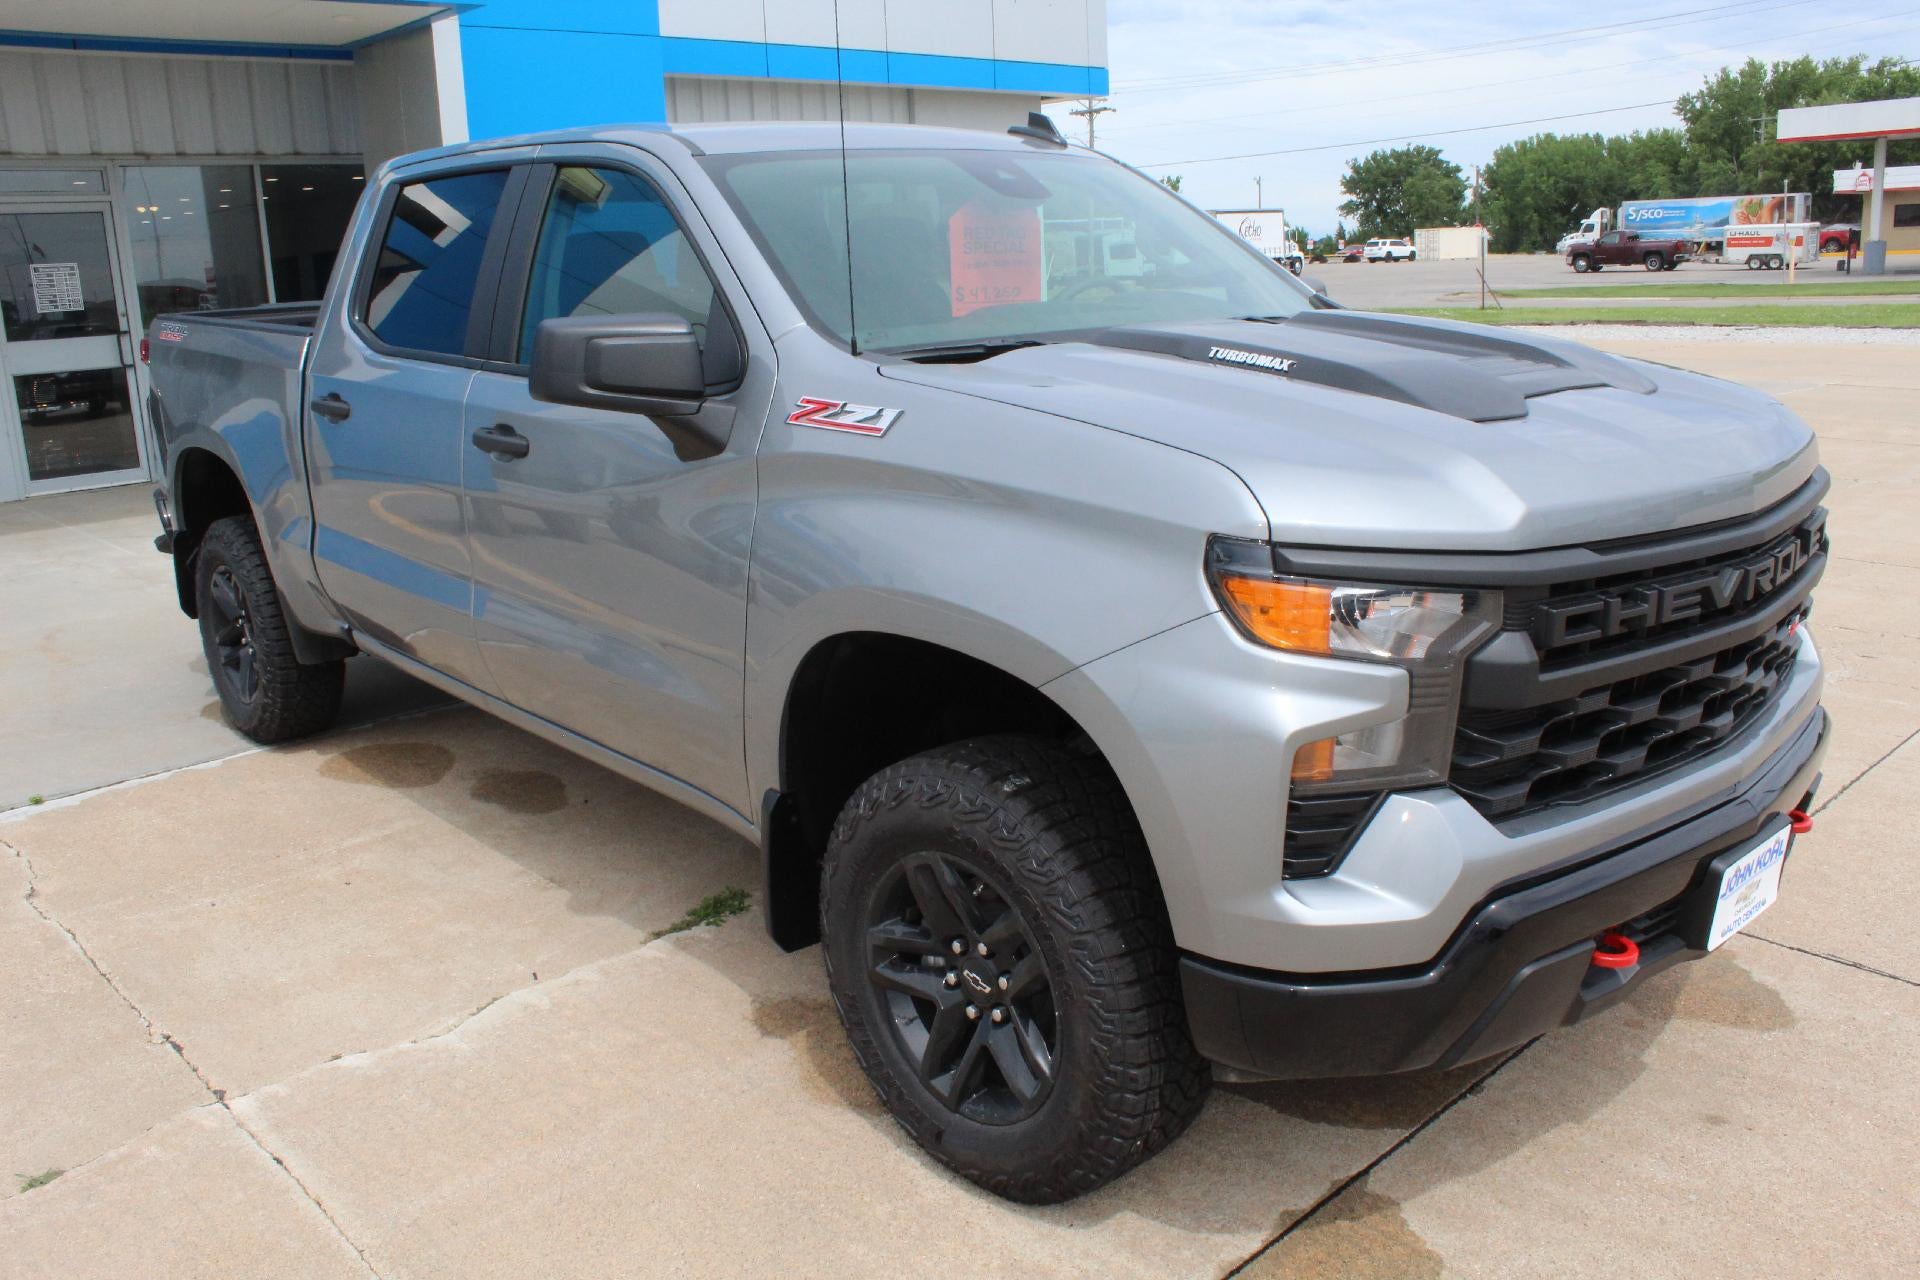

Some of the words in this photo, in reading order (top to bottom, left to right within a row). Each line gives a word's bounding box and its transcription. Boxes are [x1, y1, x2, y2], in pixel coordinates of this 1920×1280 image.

[964, 240, 1026, 255] SPECIAL
[1208, 346, 1296, 372] TURBOMAX
[784, 396, 904, 437] Z71
[1537, 505, 1829, 646] CHEVROLE
[1720, 859, 1755, 899] JOHN
[1754, 839, 1784, 871] KOHL
[1726, 916, 1742, 933] AUTO
